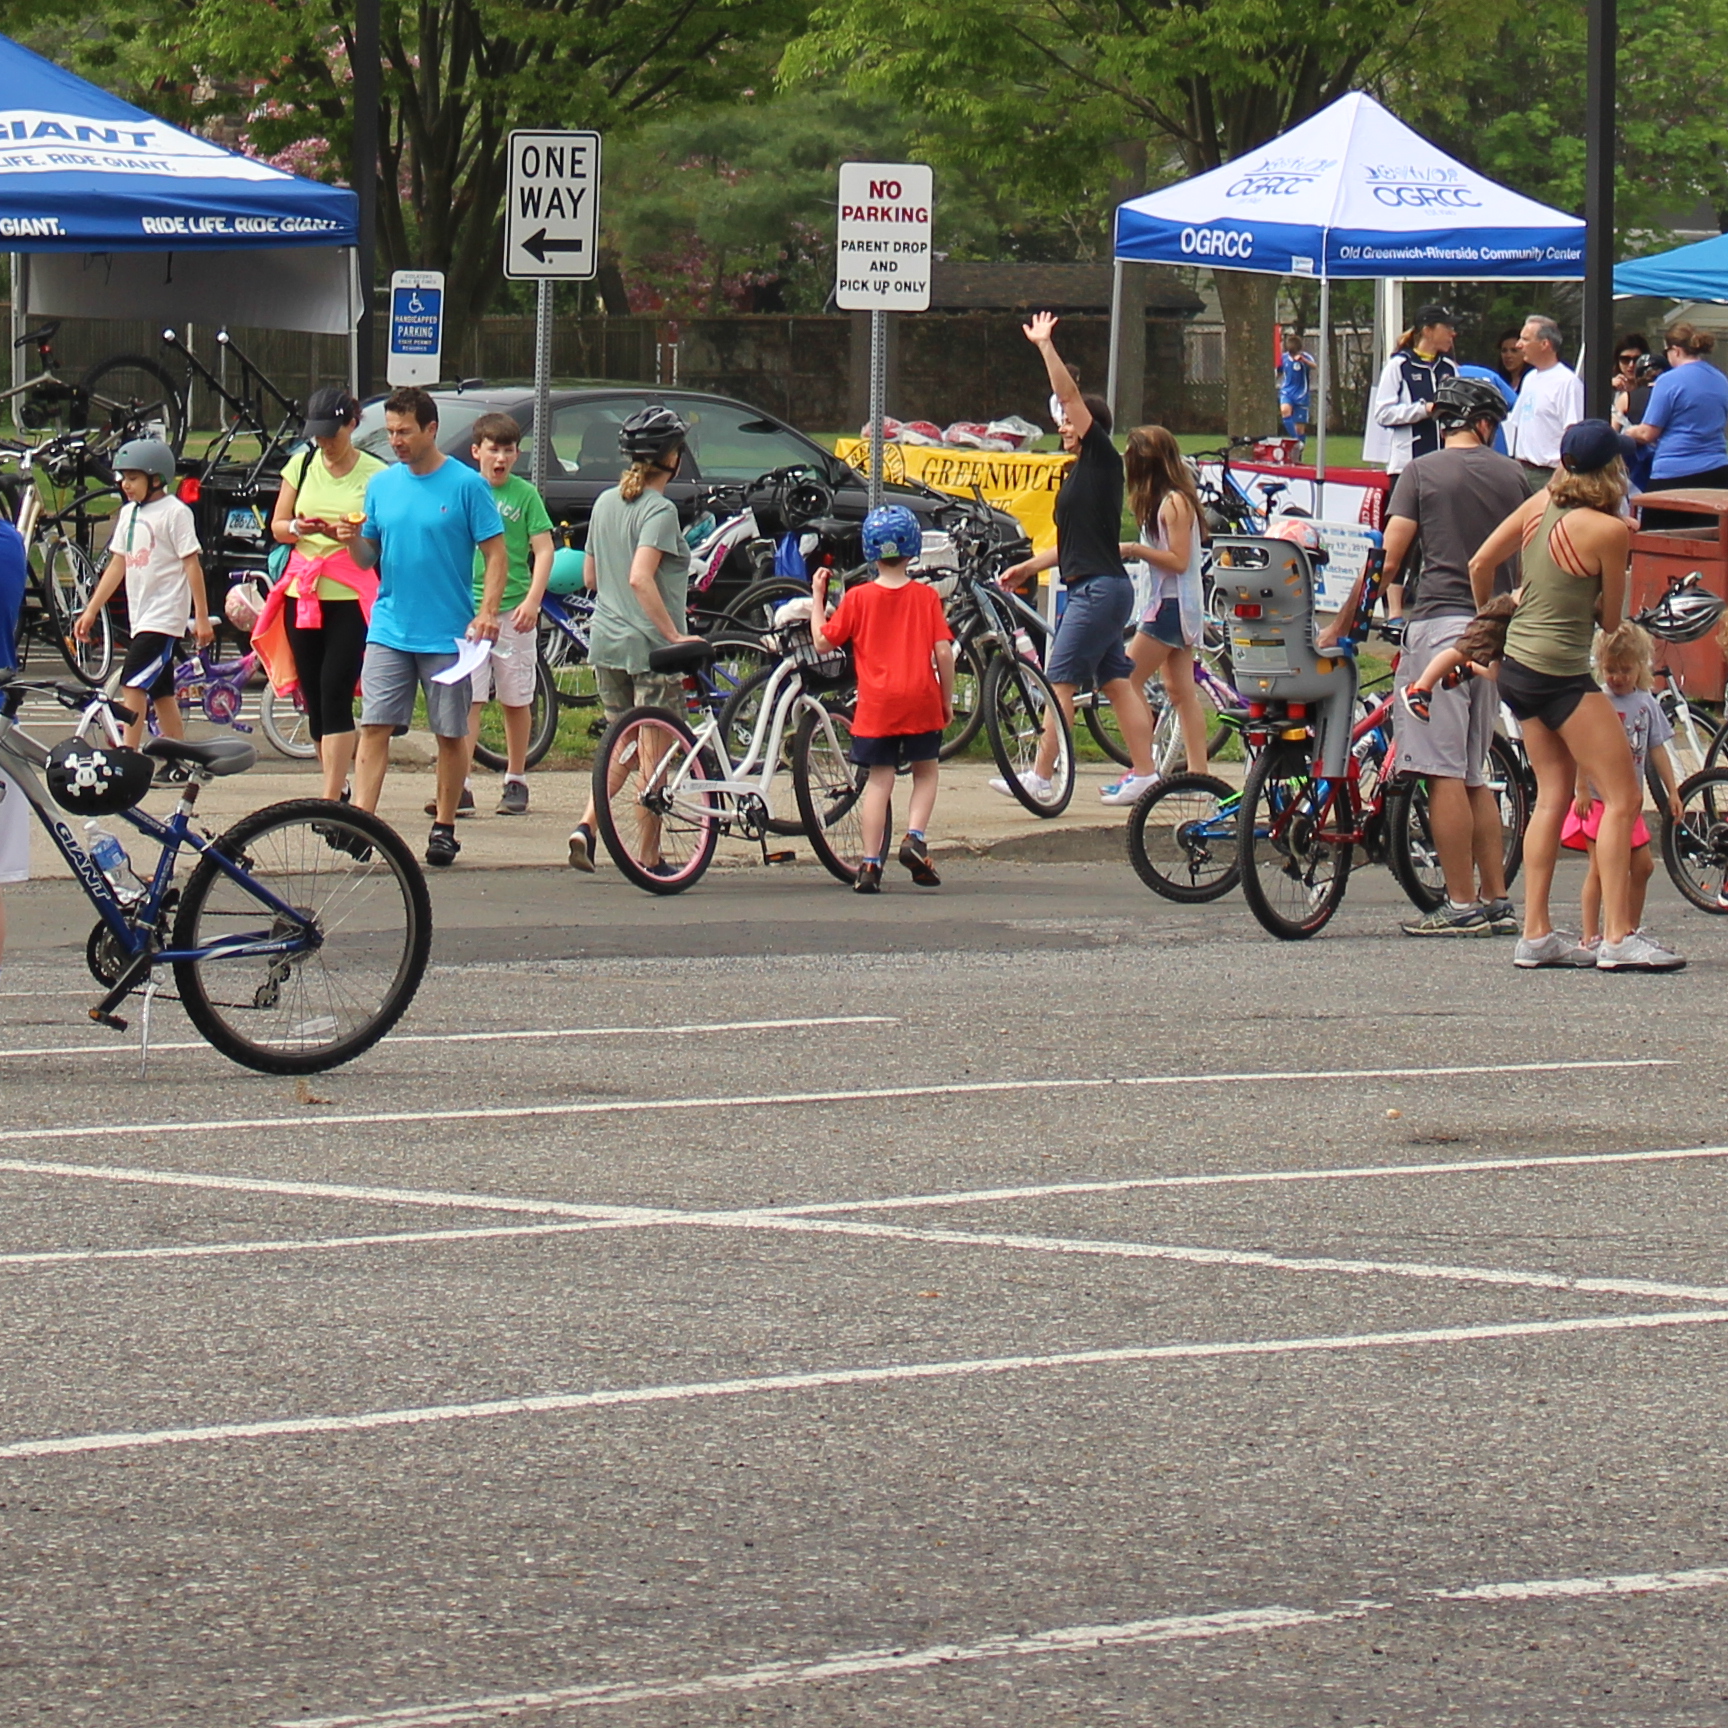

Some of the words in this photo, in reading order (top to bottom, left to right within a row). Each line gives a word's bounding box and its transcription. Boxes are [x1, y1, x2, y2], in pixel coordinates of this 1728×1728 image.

[47, 153, 96, 167] RIDE
[103, 157, 177, 172] GIANT.
[521, 145, 587, 179] ONE
[869, 180, 902, 199] NO
[1226, 176, 1314, 198] OGRCC
[1373, 186, 1483, 207] OGRCC
[520, 187, 587, 219] WAY
[842, 206, 928, 223] PARKING
[0, 217, 66, 237] GIANT.
[142, 217, 189, 233] RIDE
[189, 217, 234, 233] LIFE.
[235, 217, 279, 233] RIDE
[841, 240, 890, 252] PARENT
[893, 241, 928, 254] DROP
[1180, 227, 1253, 259] OGRCC
[1340, 246, 1361, 259] Old
[1362, 246, 1479, 261] Greenwich-Riverside
[1480, 247, 1545, 262] Community
[1546, 246, 1582, 260] Center
[870, 261, 898, 272] AND
[840, 280, 870, 292] PICK
[873, 281, 890, 292] UP
[894, 281, 927, 293] ONLY
[395, 315, 438, 325] HANDICAPPED
[398, 326, 433, 338] PARKING
[922, 456, 1065, 492] GREENWICH
[54, 820, 112, 901] GIANT
